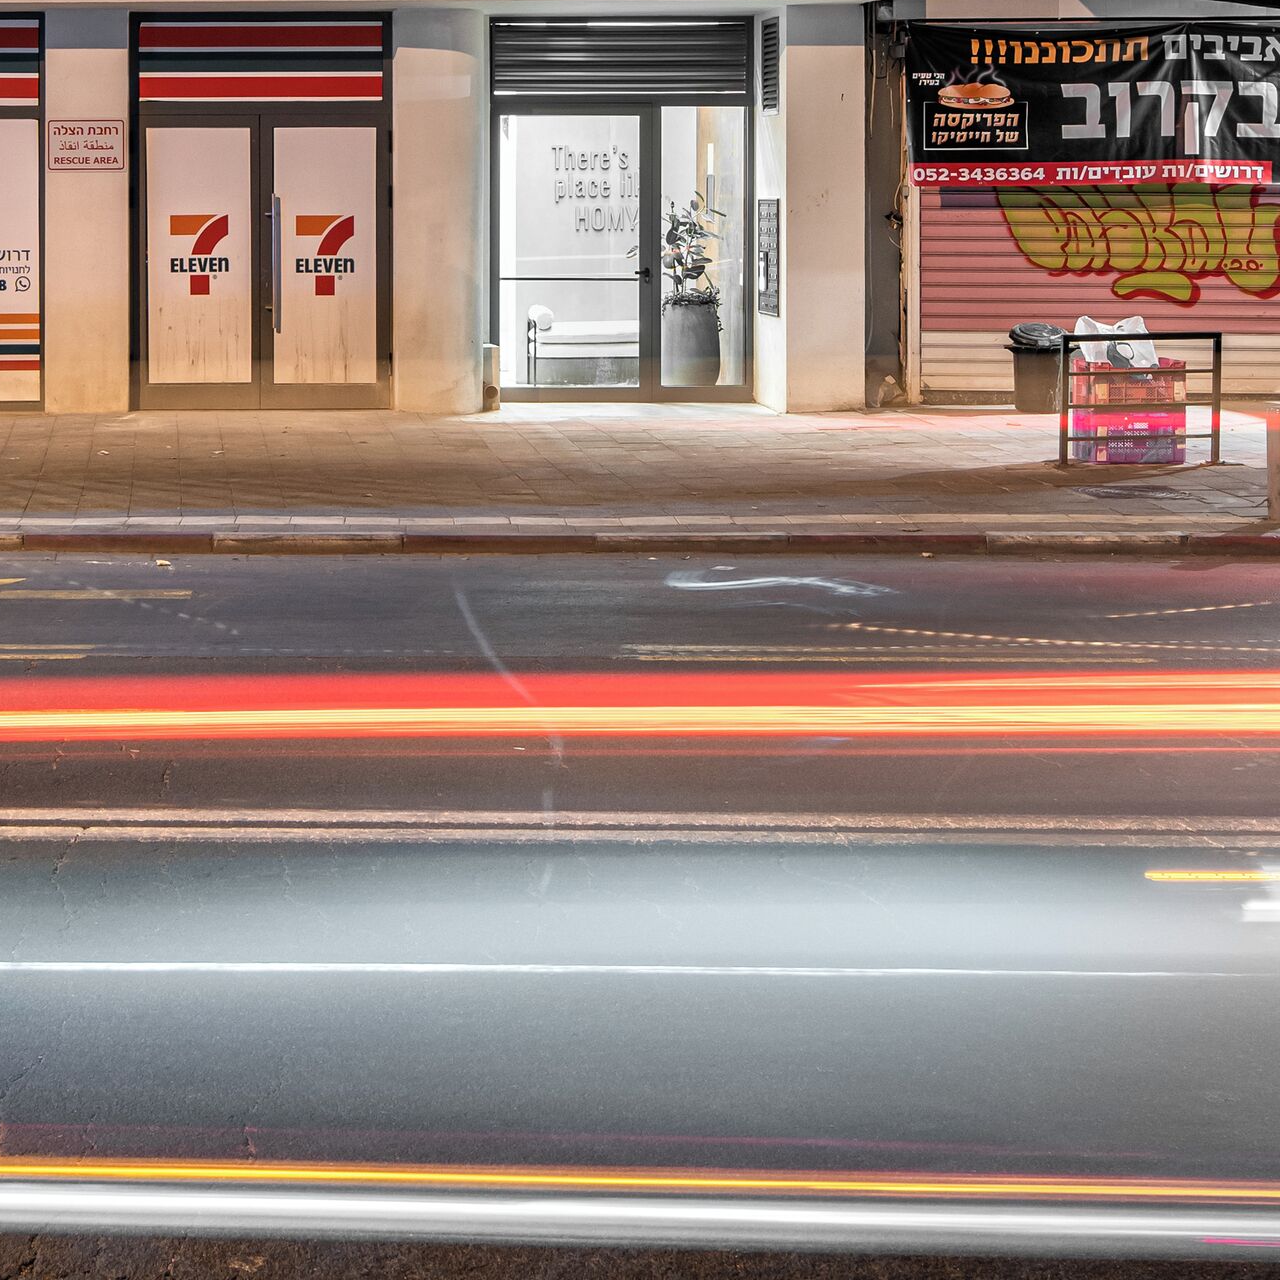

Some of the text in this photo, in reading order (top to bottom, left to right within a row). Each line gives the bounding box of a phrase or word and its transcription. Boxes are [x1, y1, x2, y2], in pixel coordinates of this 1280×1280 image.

[932, 112, 1020, 129] הפריקסה
[1060, 80, 1280, 155] בקרוב
[53, 125, 119, 136] רחבת הצלה
[931, 129, 1020, 145] של חיימיקו
[53, 156, 119, 165] RESCUE AREA
[552, 145, 629, 171] There's
[913, 167, 1046, 182] 052-3436364
[554, 173, 611, 204] place
